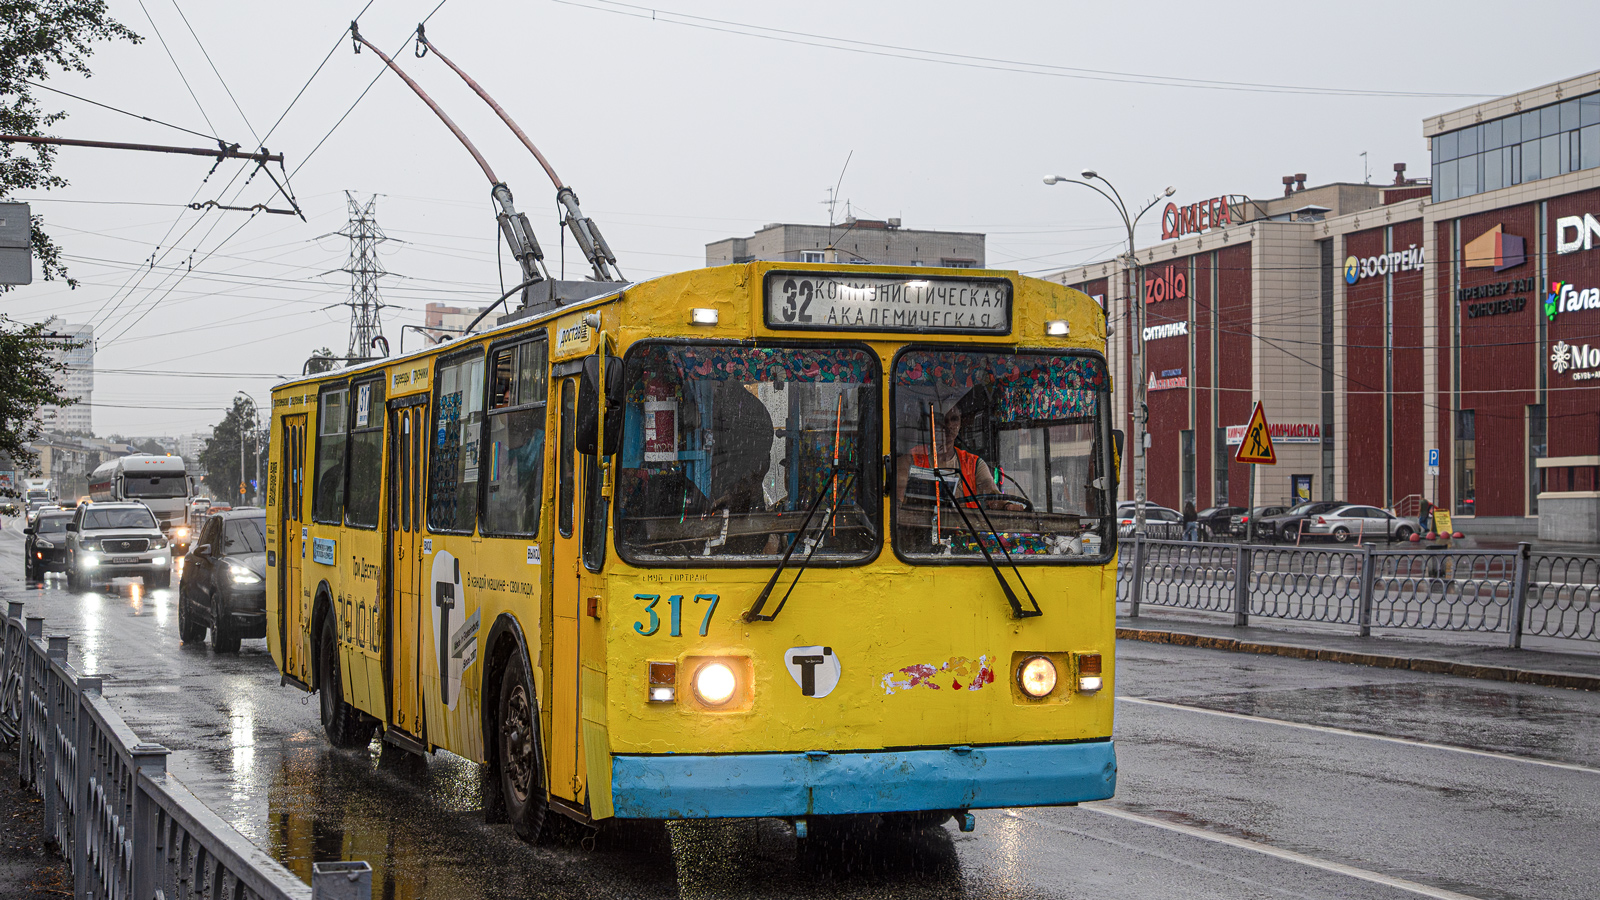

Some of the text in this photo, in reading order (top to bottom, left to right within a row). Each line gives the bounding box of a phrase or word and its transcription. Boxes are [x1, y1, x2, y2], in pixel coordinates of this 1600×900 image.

[1145, 264, 1186, 304] zolla
[1458, 276, 1535, 302] ПРЕМЬЕР ЗАЛ
[783, 278, 1004, 323] 32 КОММУНИСТИЧЕСКАЯ
[1468, 297, 1527, 319] КИНОТЕАТР
[827, 306, 991, 328] АКАДЕМИЧЕСКАЯ
[1143, 321, 1189, 341] СИТИЛИНК
[633, 593, 720, 637] 317
